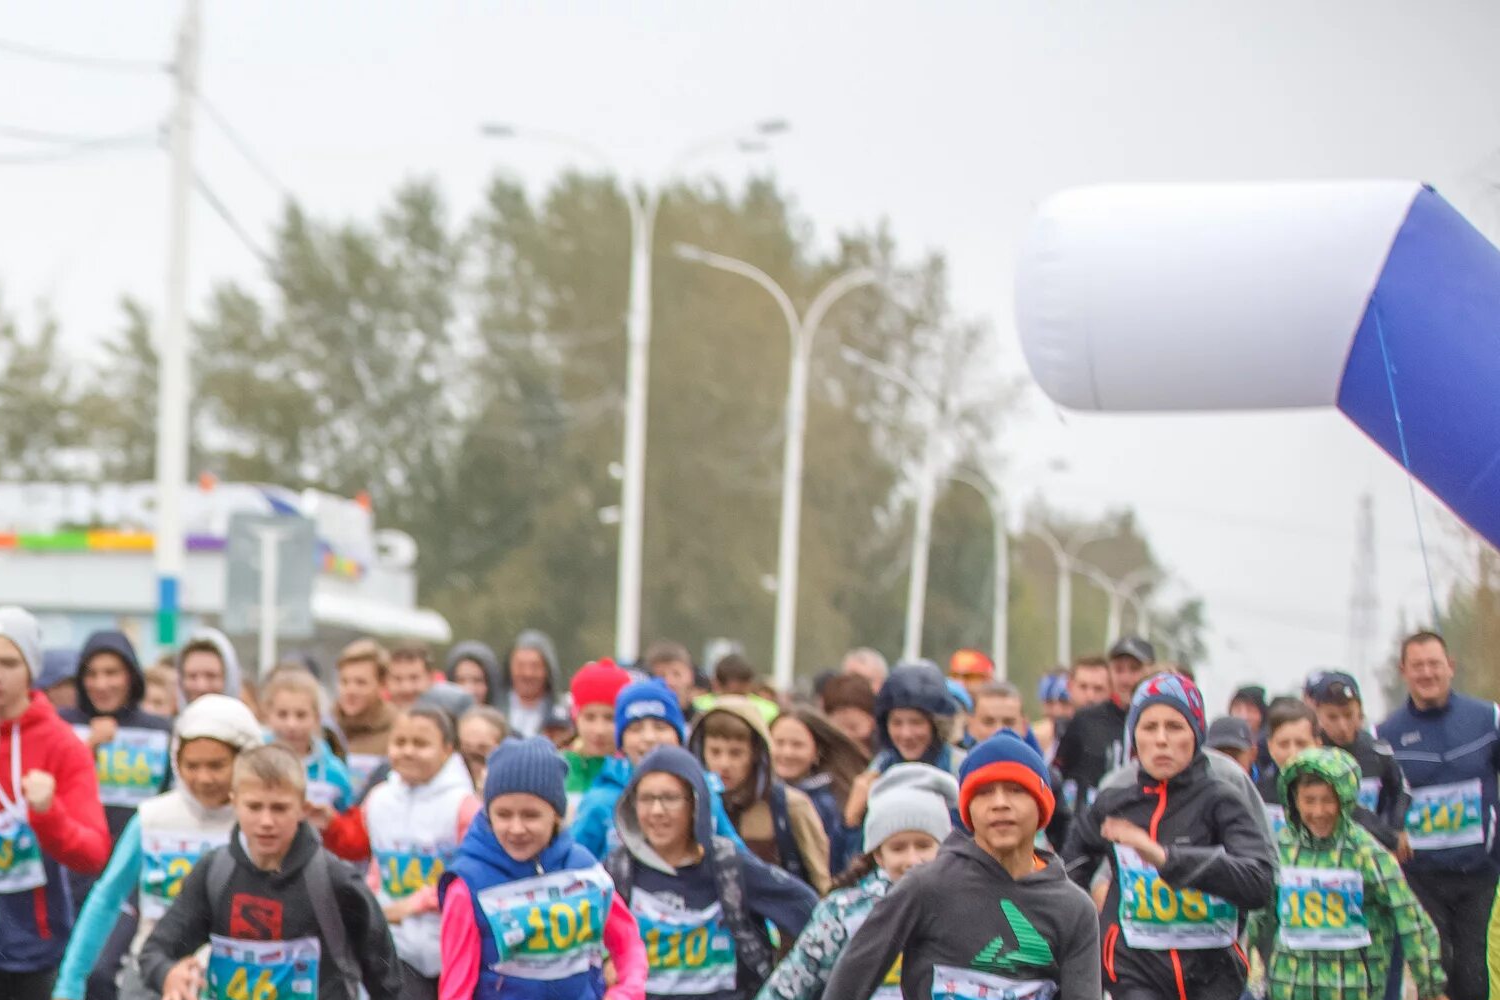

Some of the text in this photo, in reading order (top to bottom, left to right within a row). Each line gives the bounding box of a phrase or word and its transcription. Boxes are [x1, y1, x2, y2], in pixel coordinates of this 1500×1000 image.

[528, 900, 593, 949] 101
[1289, 892, 1346, 927] 188
[646, 928, 707, 966] 110
